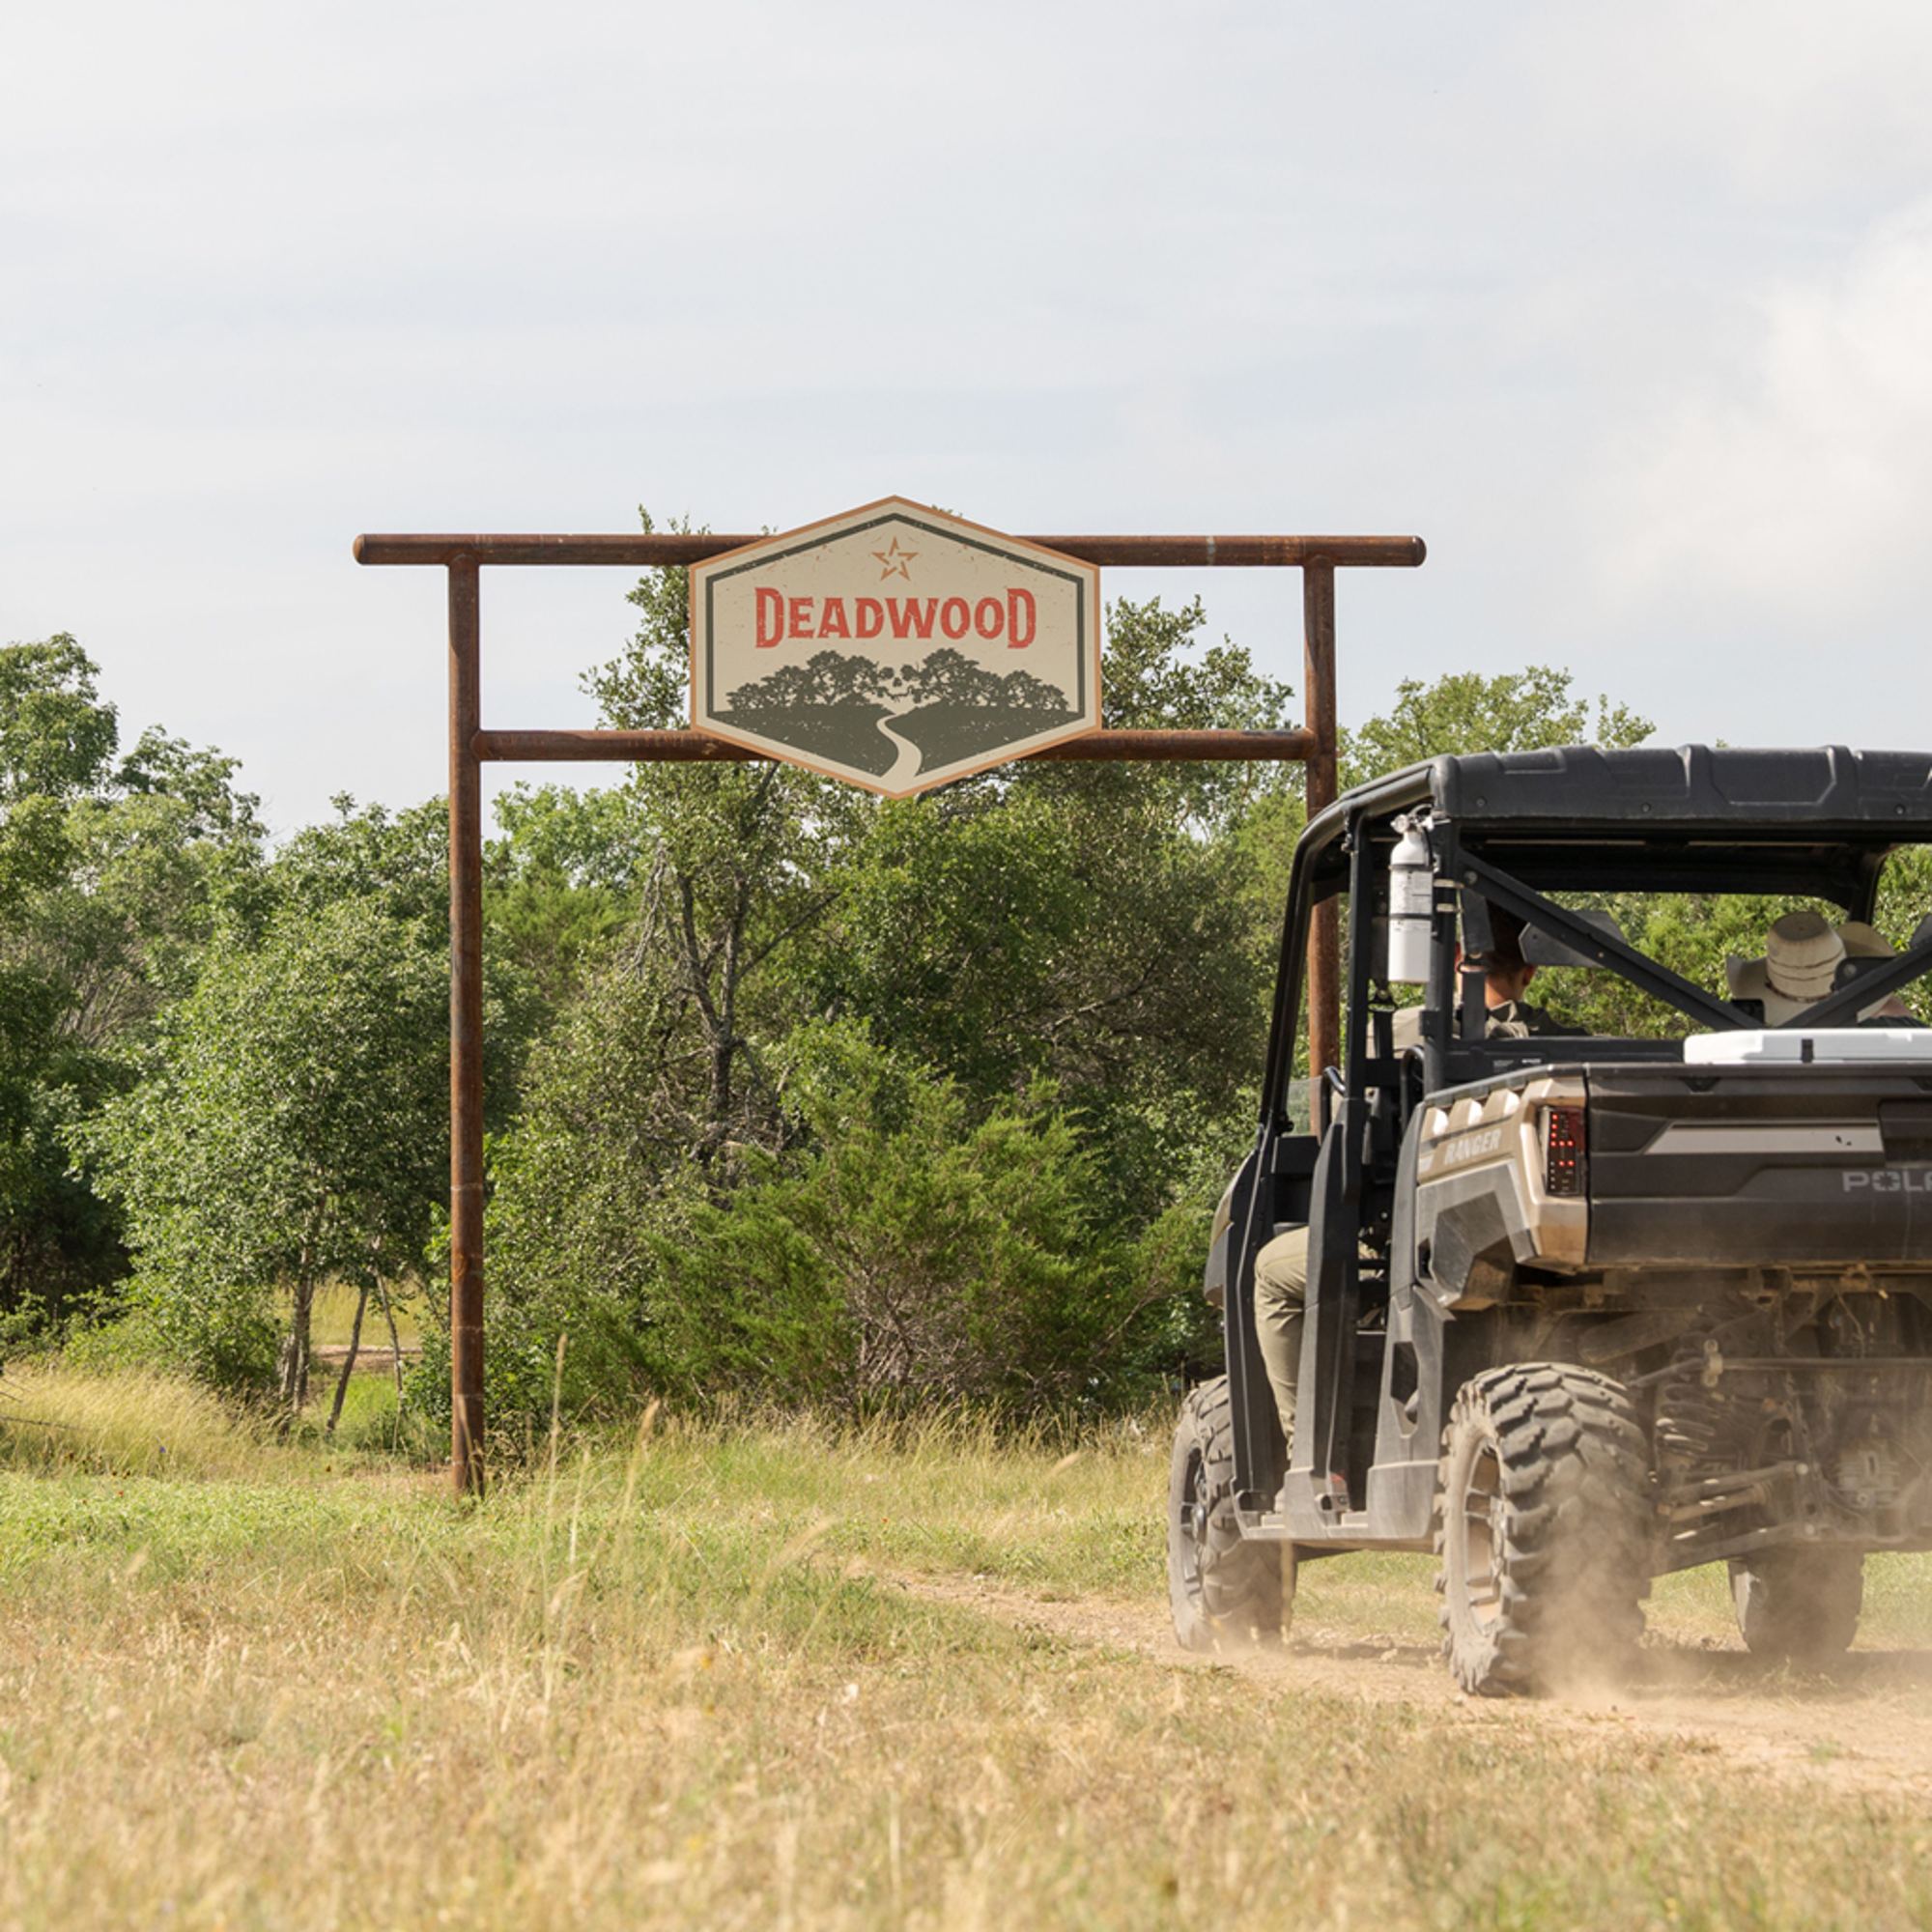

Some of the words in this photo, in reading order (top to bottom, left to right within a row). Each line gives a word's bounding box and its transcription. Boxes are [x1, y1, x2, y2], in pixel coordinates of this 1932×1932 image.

[754, 586, 1036, 649] DEADWOOD
[1444, 1128, 1502, 1165] RANGER
[1842, 1170, 1932, 1193] POL
